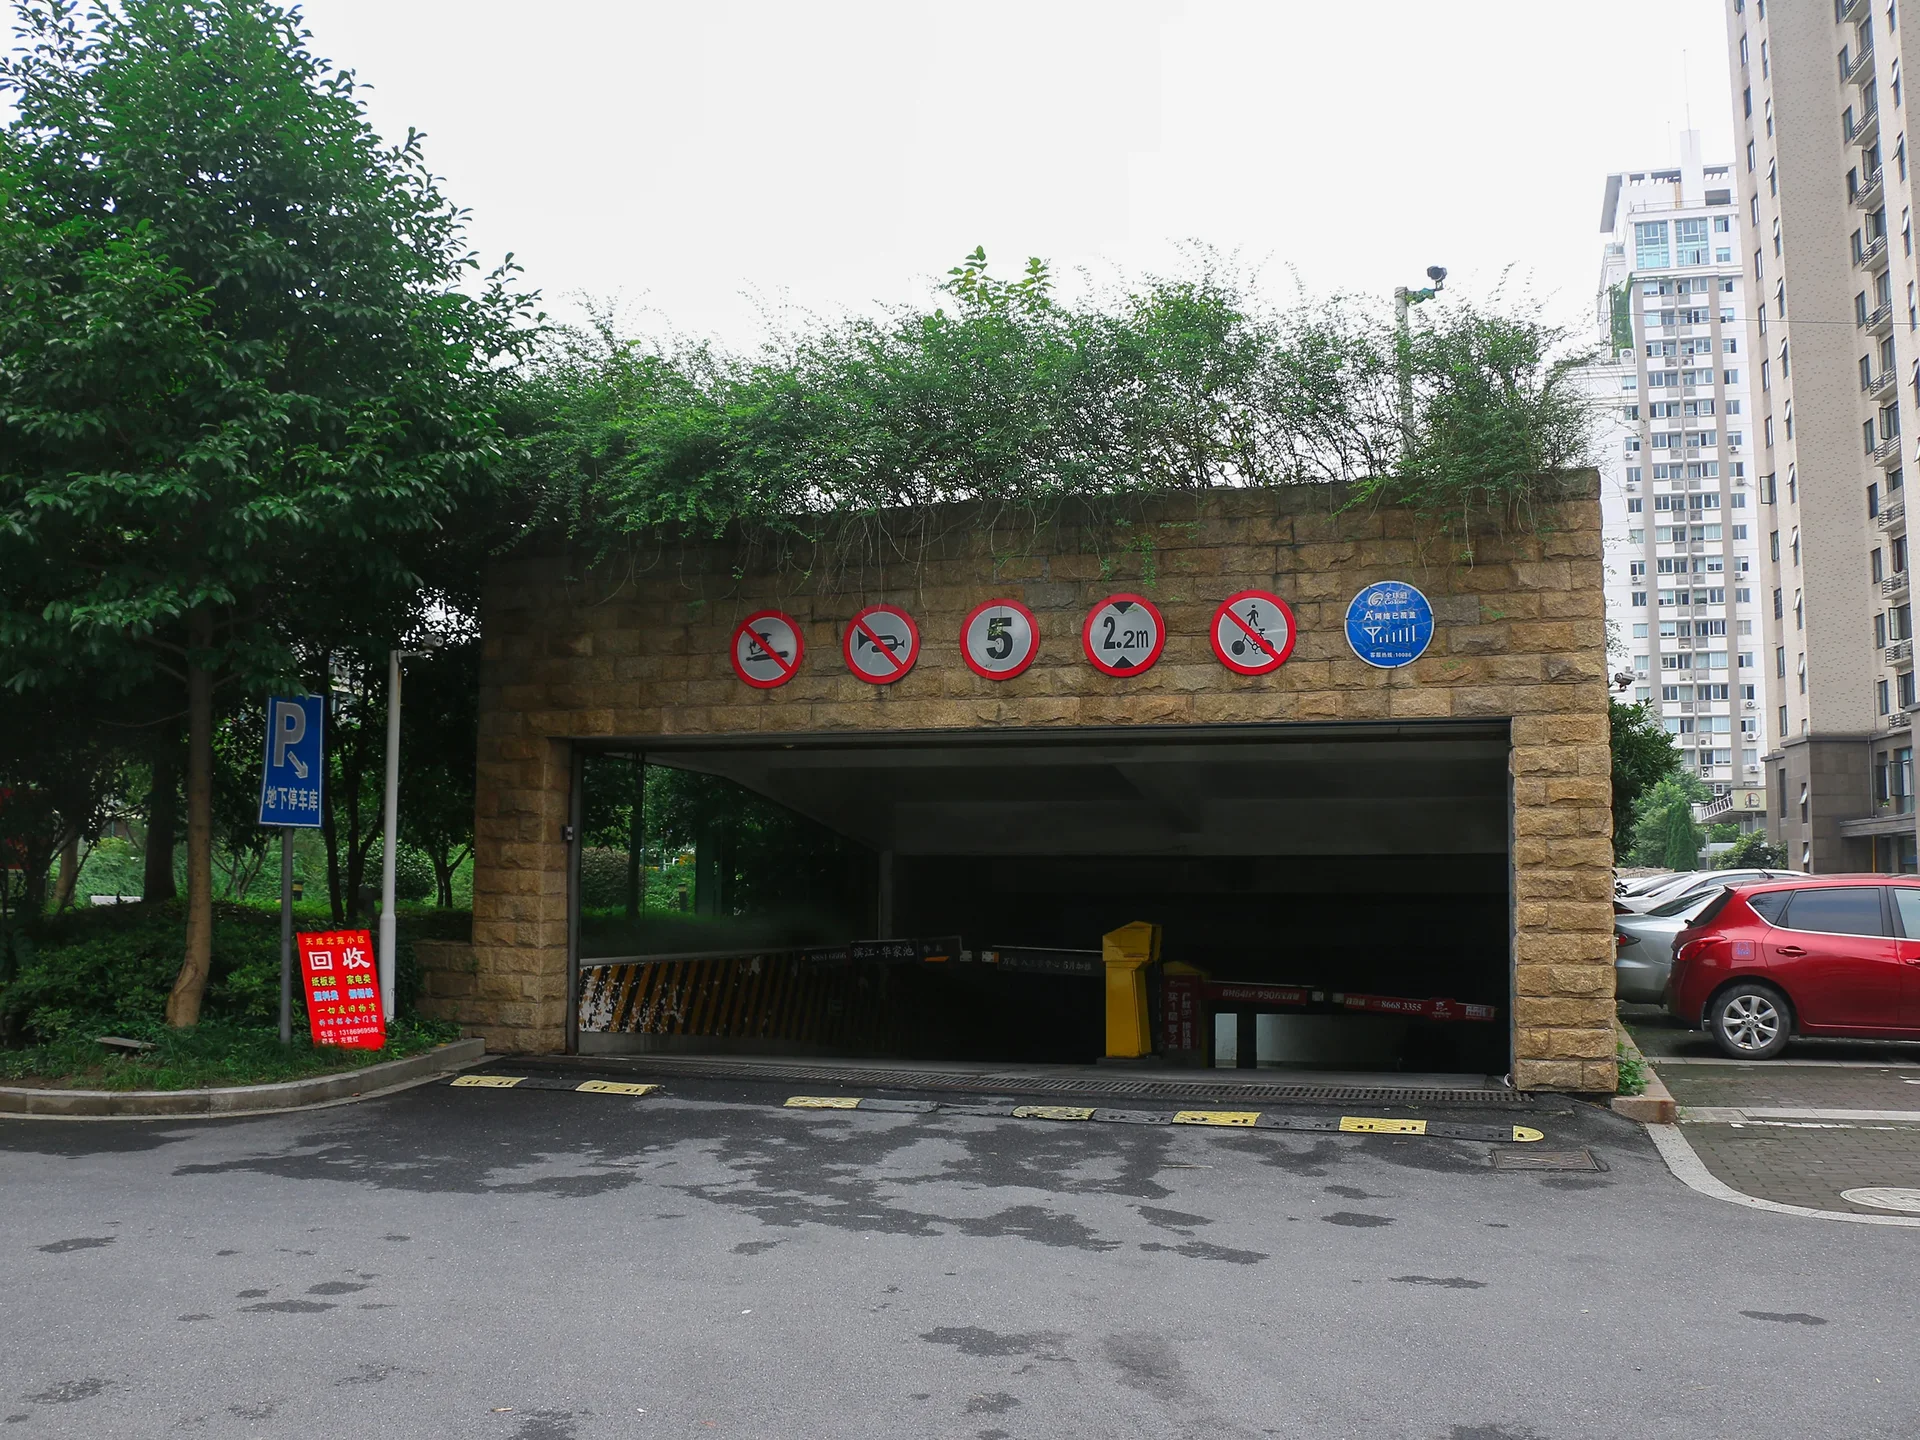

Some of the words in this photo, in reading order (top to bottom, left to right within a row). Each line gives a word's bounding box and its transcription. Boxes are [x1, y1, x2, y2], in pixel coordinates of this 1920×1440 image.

[986, 617, 1013, 660] 5
[1103, 616, 1149, 650] 2.2m
[273, 701, 306, 767] P
[265, 785, 318, 811] 地下停车库
[305, 936, 365, 946] 天成北苑小区
[308, 947, 371, 970] 回收
[853, 944, 915, 959] 滨江·华家池
[311, 975, 337, 987] 纸板类
[346, 974, 372, 985] 家电类
[317, 1002, 377, 1015] 一切废旧物资
[1381, 1000, 1401, 1009] 8668
[1402, 1002, 1422, 1011] 3355
